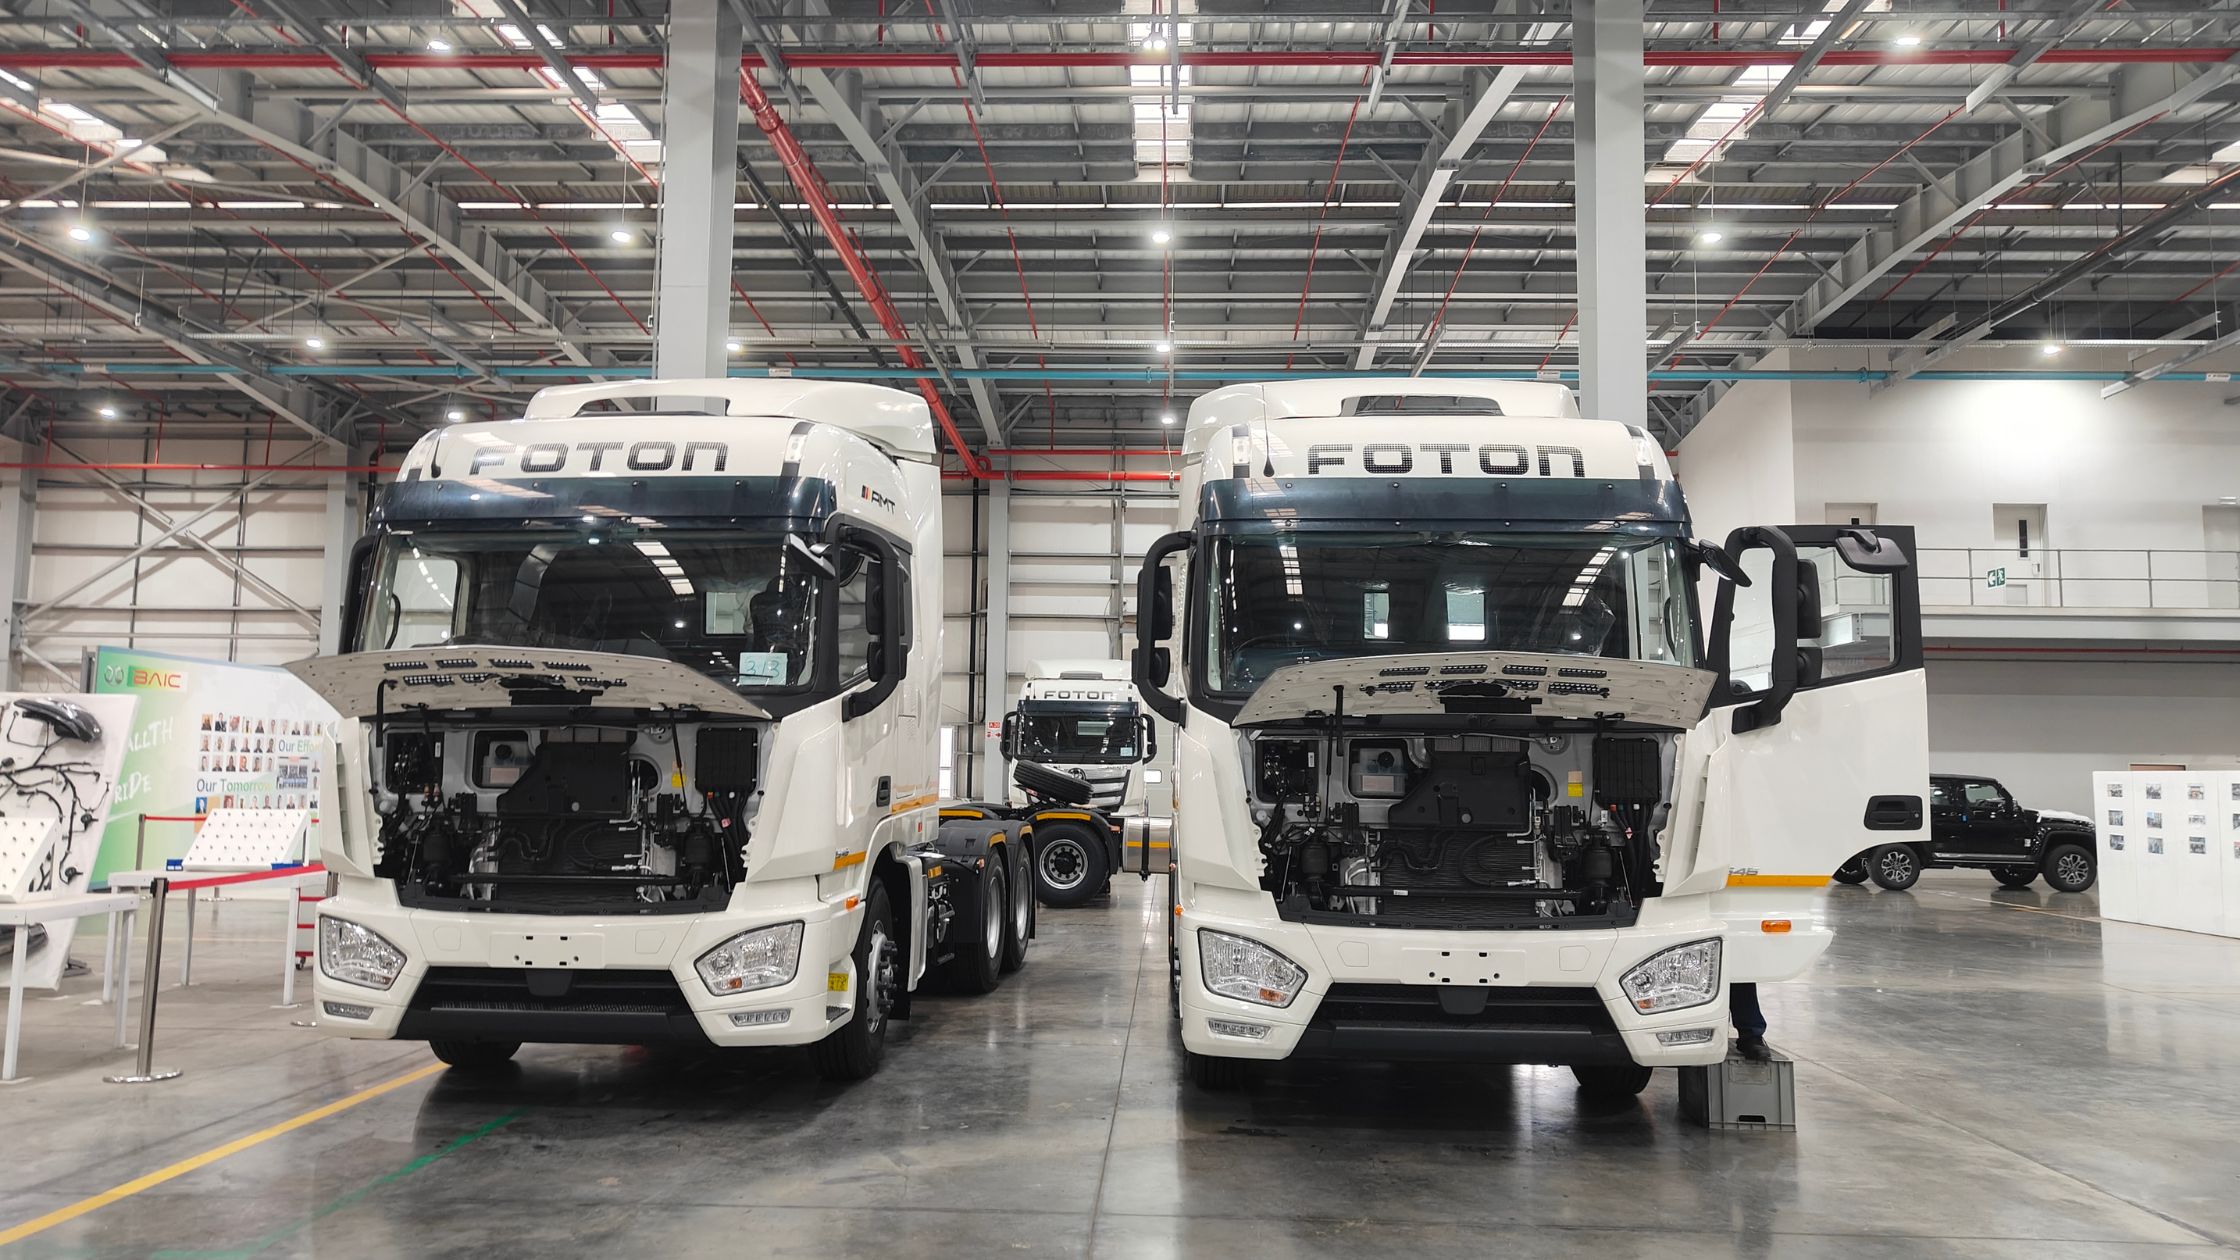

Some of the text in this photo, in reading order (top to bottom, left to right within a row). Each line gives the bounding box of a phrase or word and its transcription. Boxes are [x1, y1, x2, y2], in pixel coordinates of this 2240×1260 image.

[469, 441, 729, 476] FOTON
[1307, 443, 1586, 478] FOTON
[871, 490, 896, 515] AMT
[133, 669, 182, 688] BAIC
[278, 739, 295, 752] Our
[196, 778, 274, 794] Our Tomorrow
